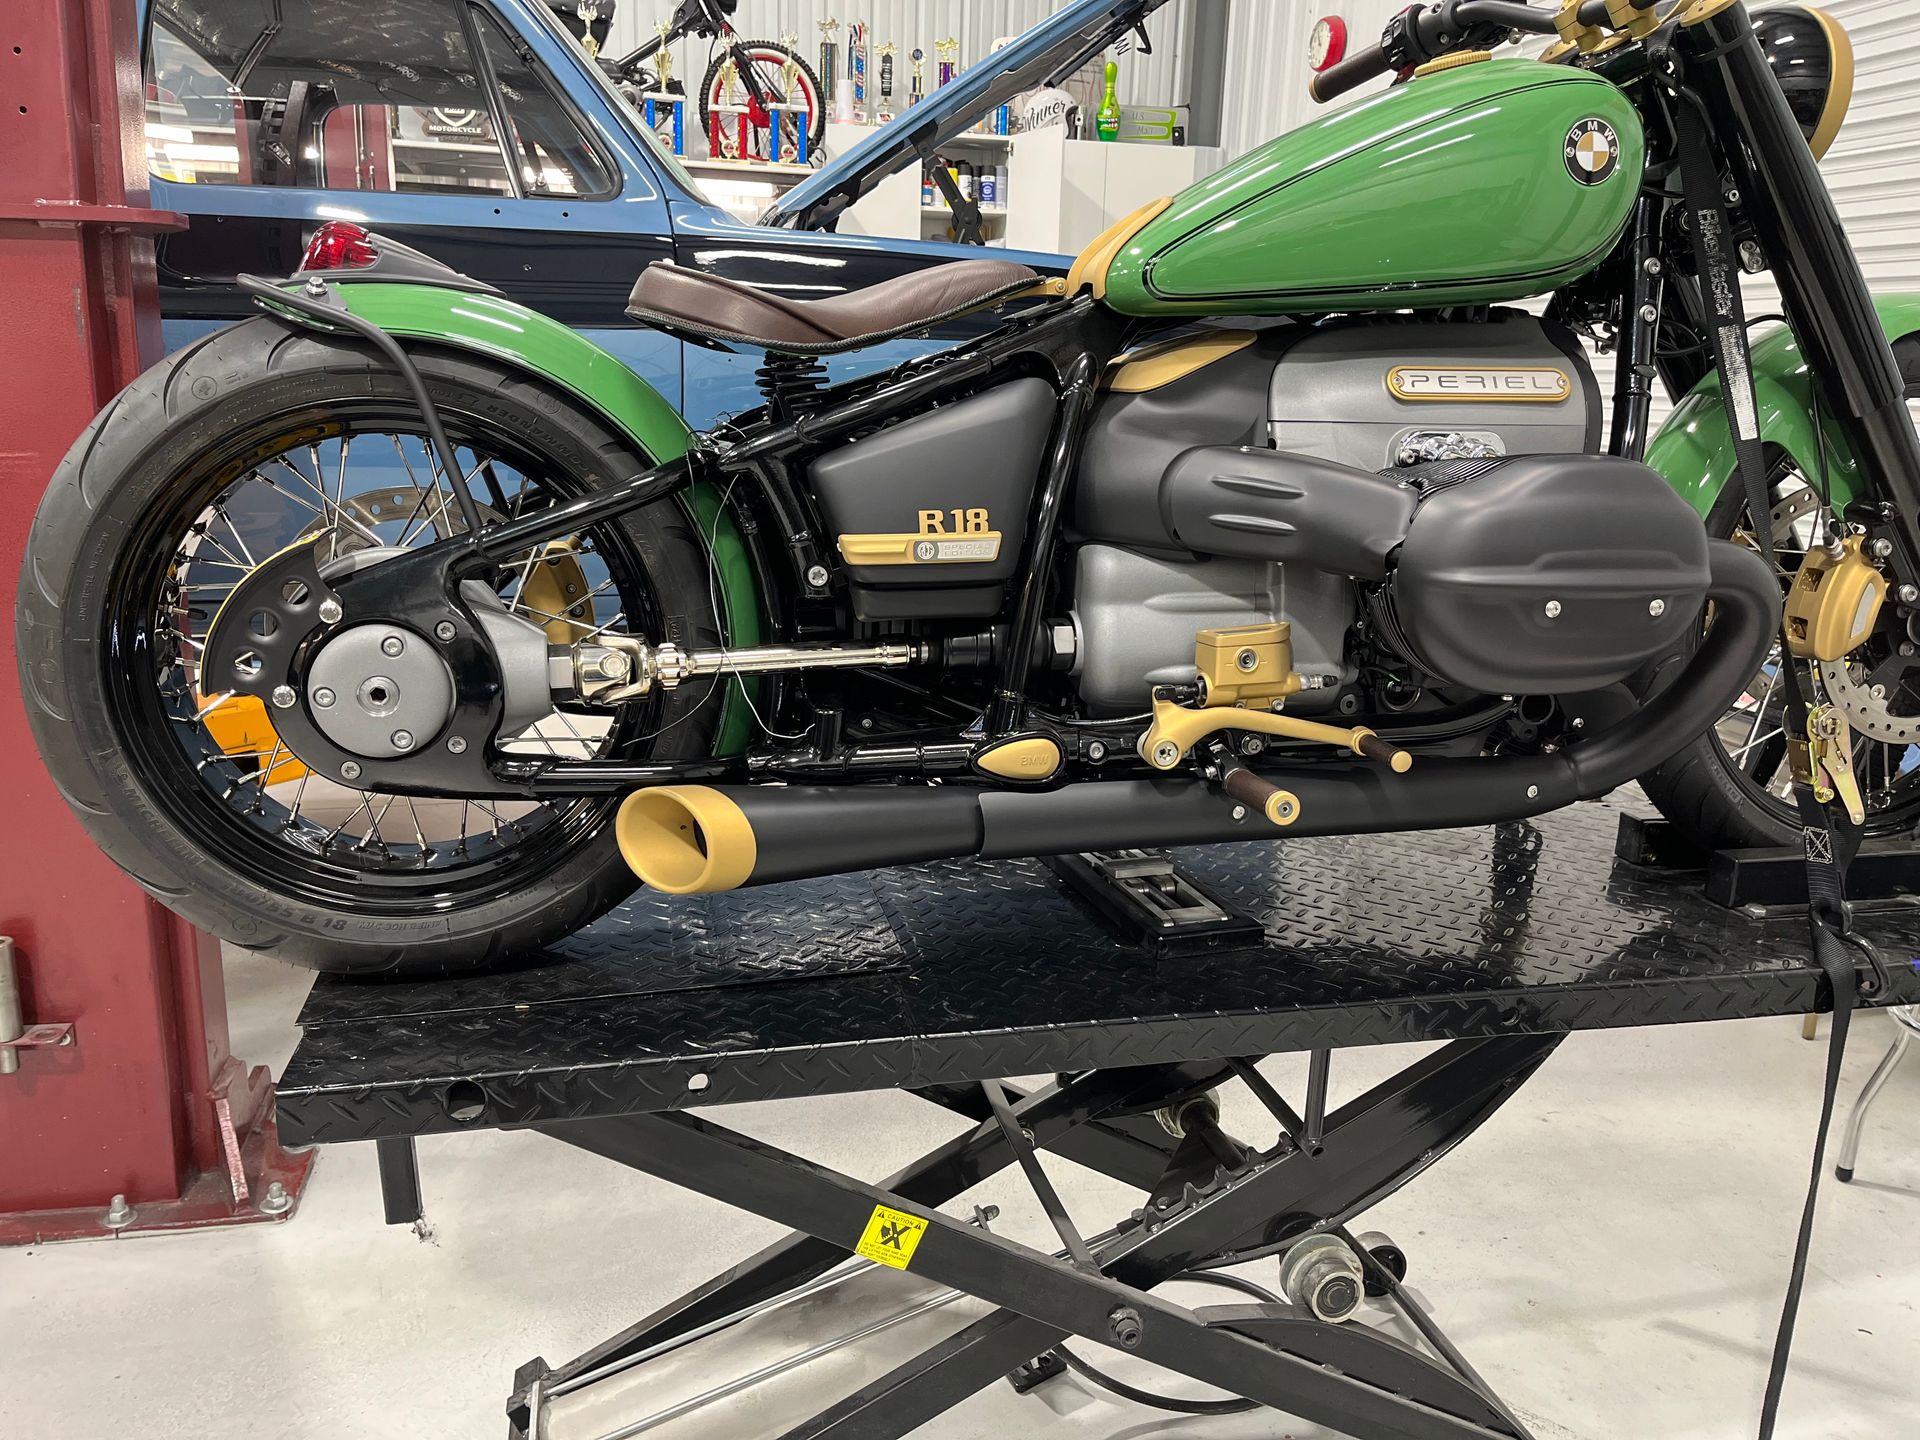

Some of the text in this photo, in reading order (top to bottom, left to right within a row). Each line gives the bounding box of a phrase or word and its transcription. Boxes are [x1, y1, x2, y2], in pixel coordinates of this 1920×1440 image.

[1023, 100, 1066, 131] Winner
[428, 125, 482, 134] MOTORCYCLE
[1570, 121, 1615, 141] BMW
[918, 508, 989, 535] R 18
[1021, 754, 1049, 767] BMW
[887, 1213, 914, 1226] CAUTION
